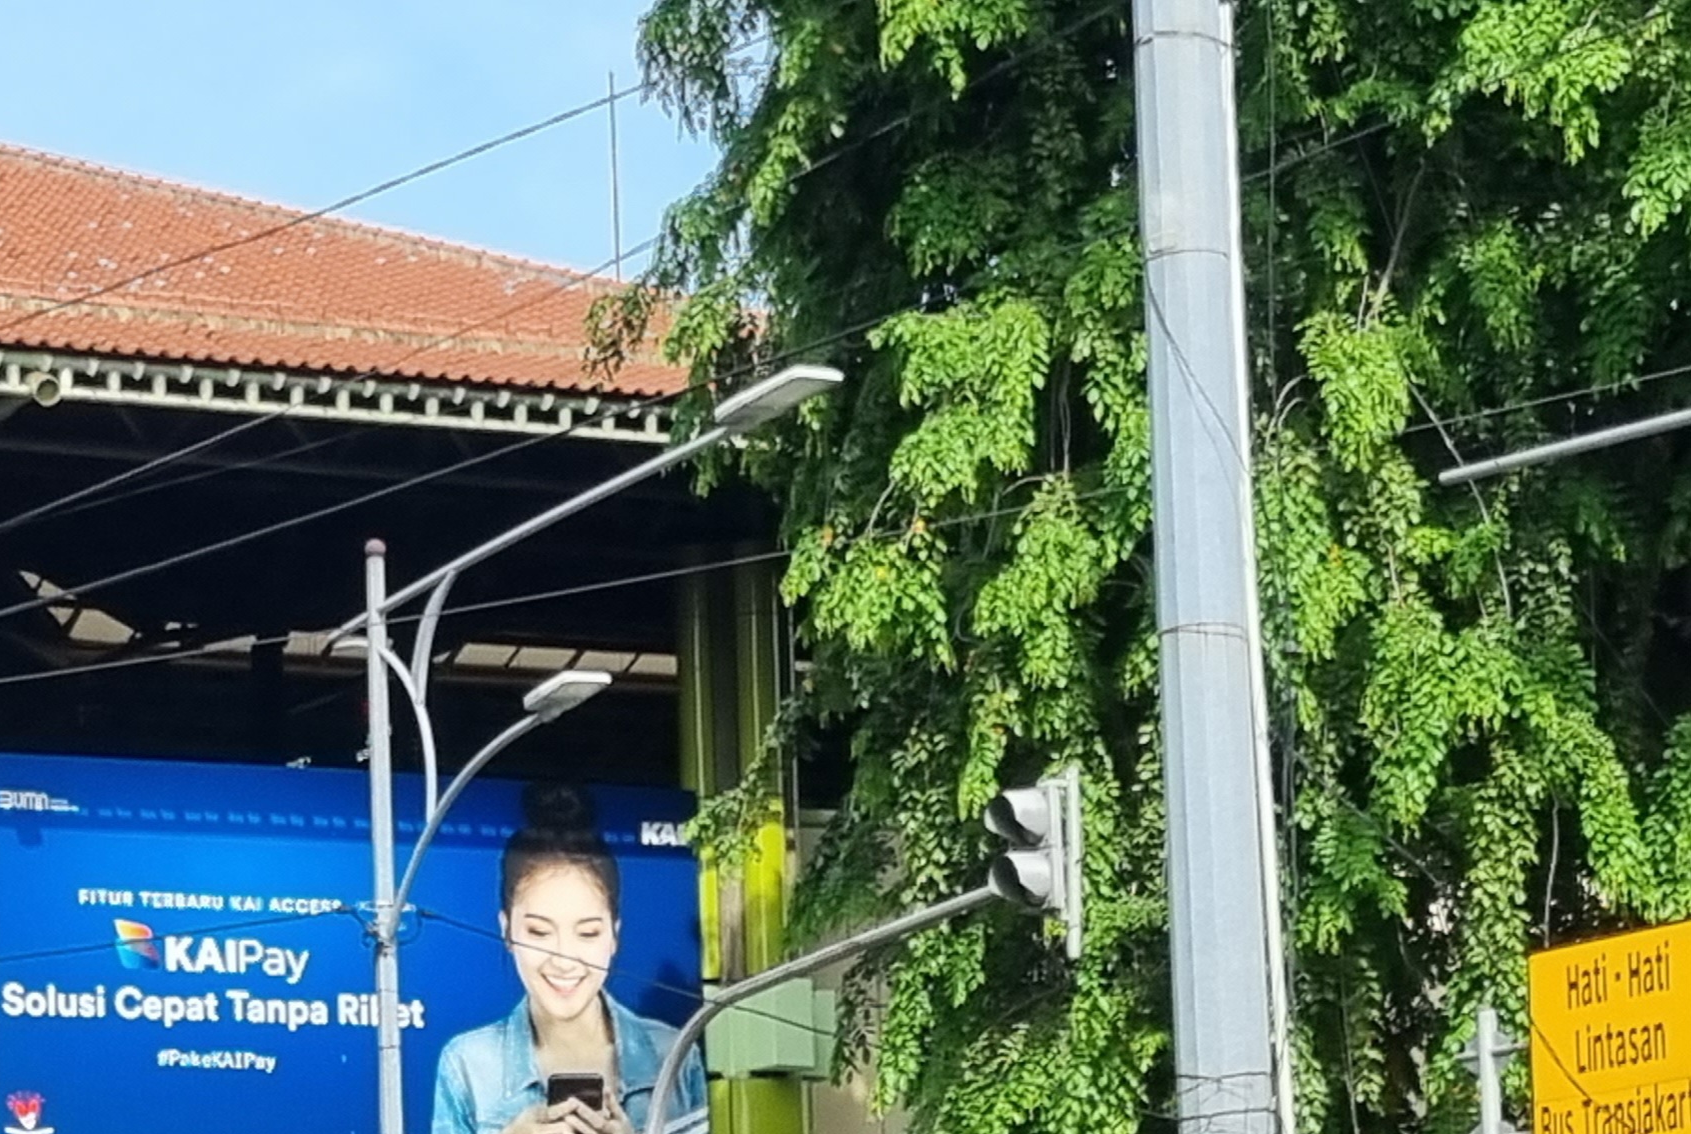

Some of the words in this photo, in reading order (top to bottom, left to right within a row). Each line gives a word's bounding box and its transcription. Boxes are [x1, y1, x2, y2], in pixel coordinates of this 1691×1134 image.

[78, 889, 134, 907] FITUR
[139, 891, 224, 910] TERBARU
[229, 895, 264, 912] KAI
[163, 935, 309, 984] KAIPay
[1566, 953, 1608, 1010] Hati
[1628, 940, 1670, 998] Hati
[2, 981, 106, 1019] Solusi
[114, 985, 219, 1027] Cepat
[225, 989, 329, 1032] Tanpa
[157, 1048, 277, 1074] #PakeKAIPay
[1575, 1021, 1666, 1075] Lintasan
